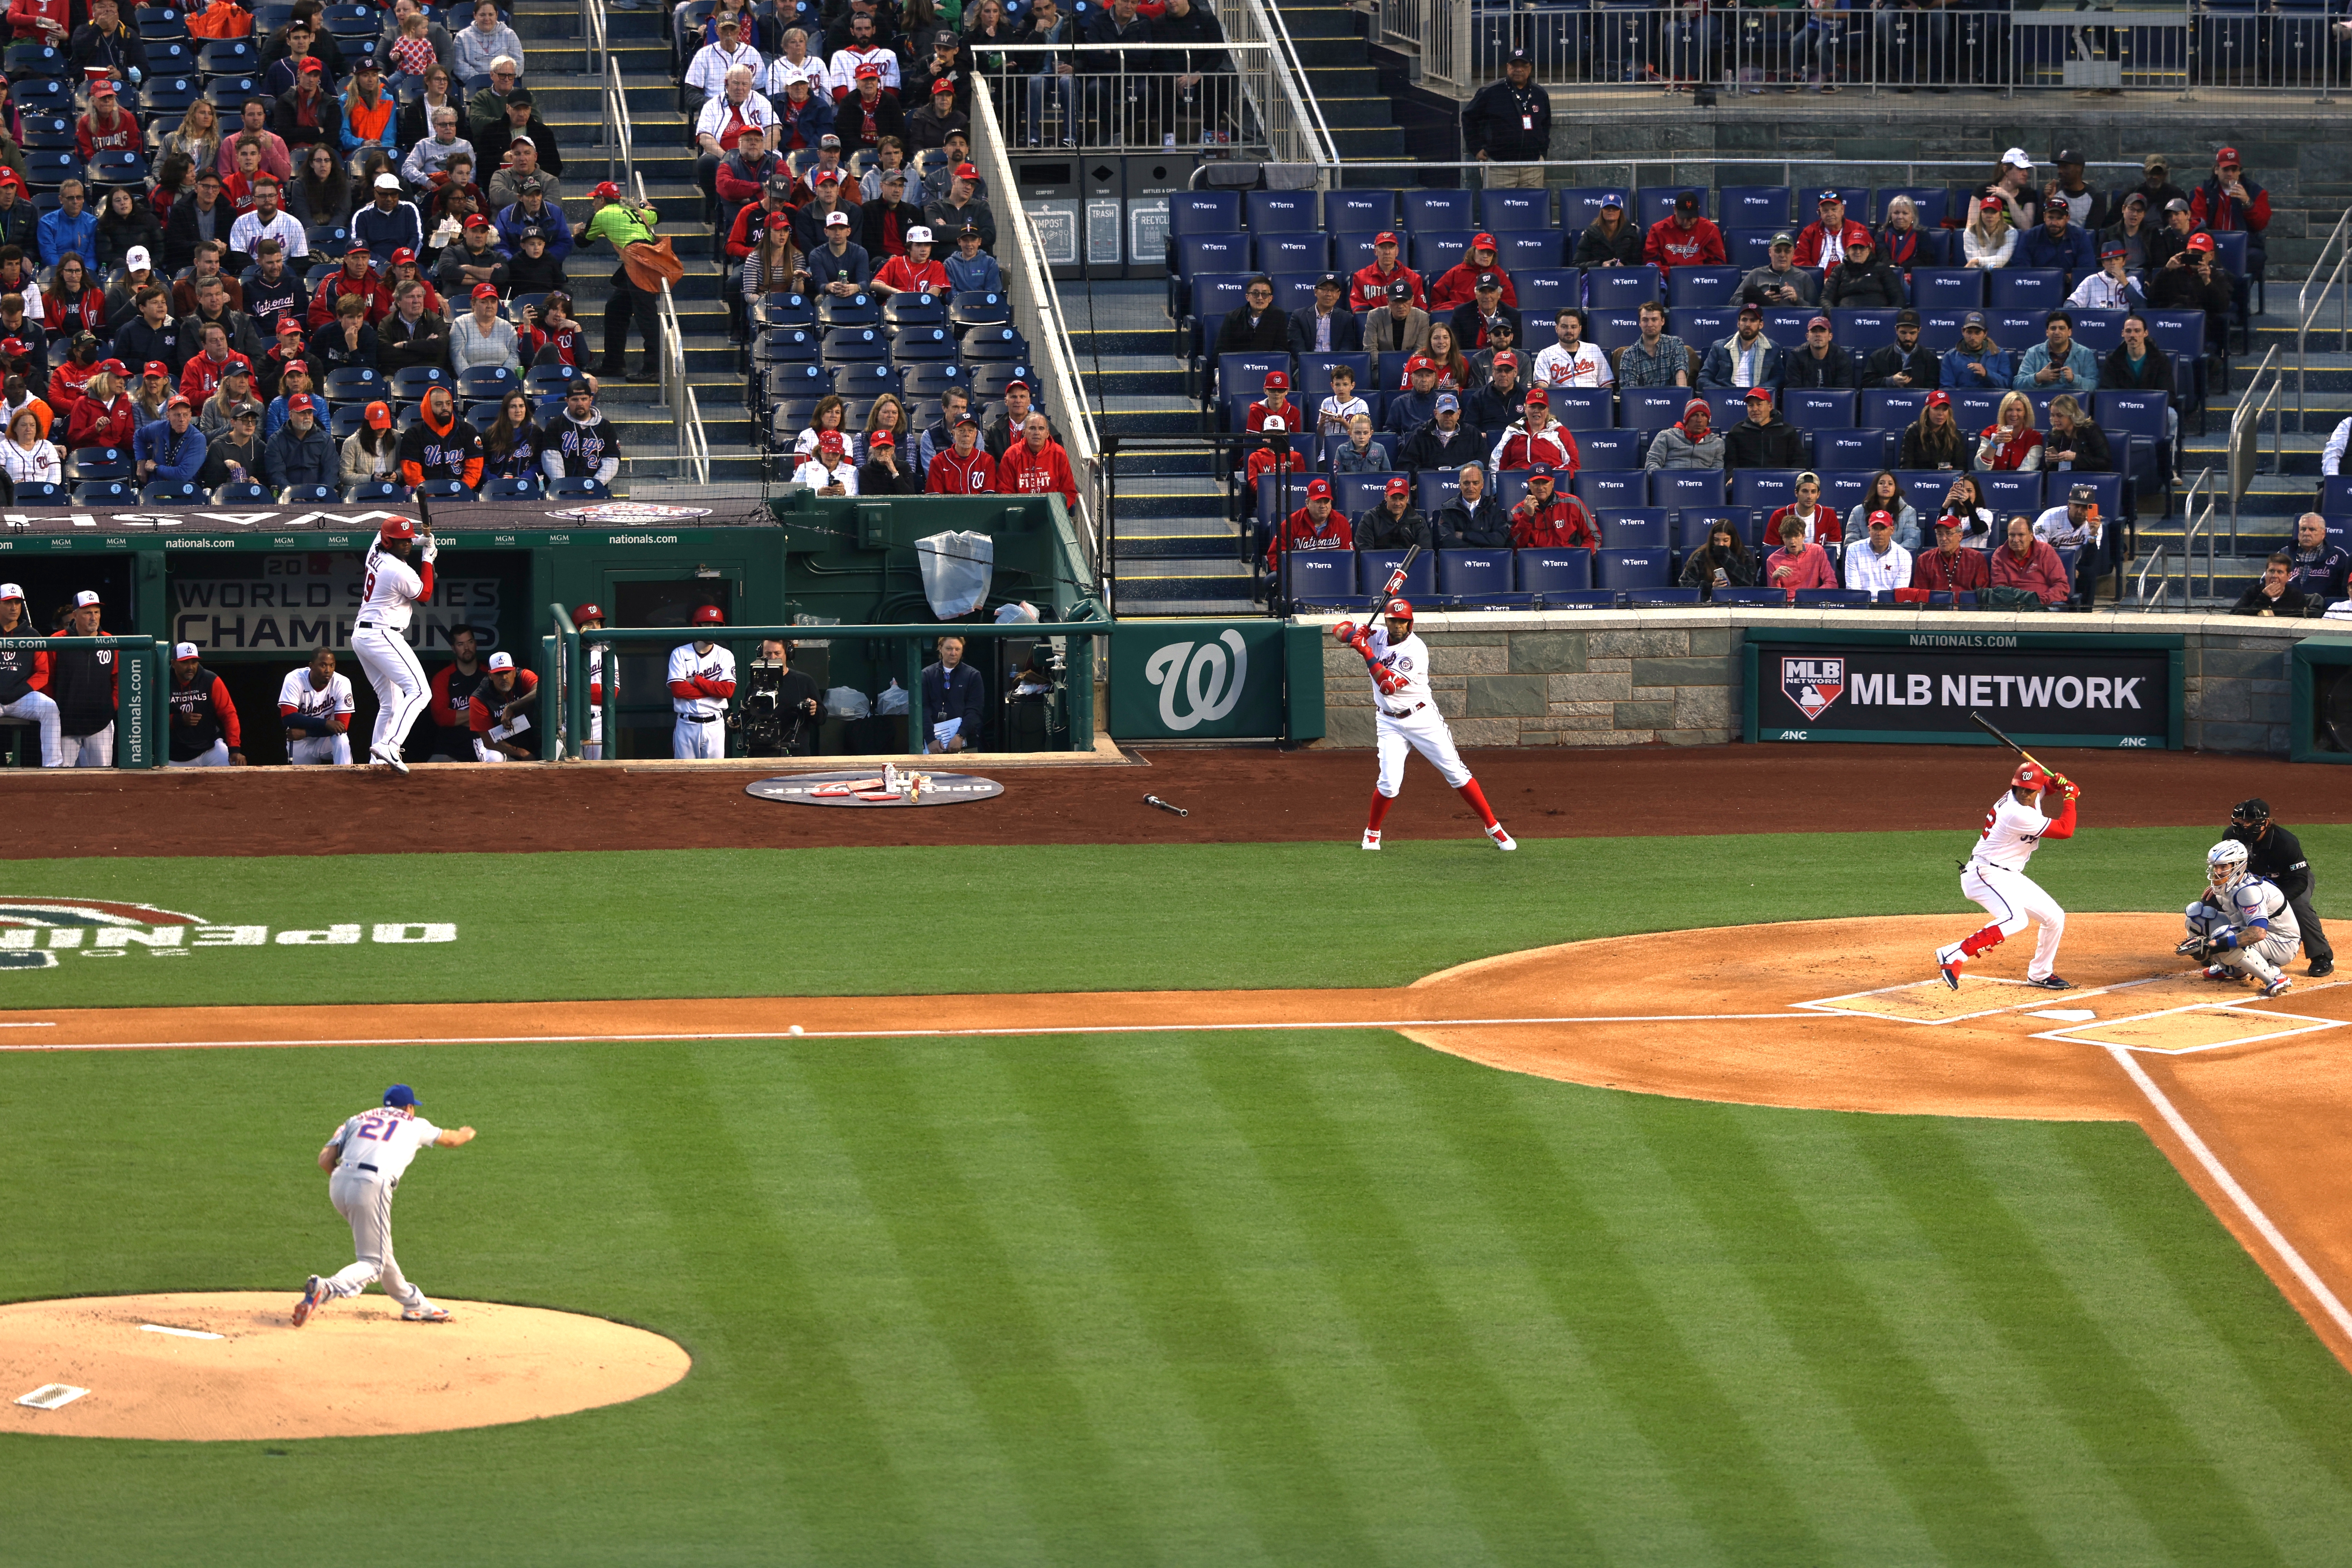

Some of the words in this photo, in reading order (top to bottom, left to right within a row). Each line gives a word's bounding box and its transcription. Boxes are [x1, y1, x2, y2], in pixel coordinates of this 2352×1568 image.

[1092, 210, 1114, 218] TRASH
[166, 538, 234, 548] nationals.com
[609, 534, 677, 544] nationals.com
[1294, 534, 1341, 551] Nationals
[368, 552, 383, 573] BELL
[179, 583, 331, 608] WORLD
[1909, 635, 2017, 648] NATIONALS.COM
[1786, 661, 1840, 678] MLB
[1145, 629, 1247, 730] W
[1851, 673, 1932, 706] MLB
[1942, 675, 2141, 709] NETWORK
[131, 659, 142, 763] nationals.com
[1780, 731, 1807, 740] ANC
[2119, 737, 2147, 746] ANC
[357, 1116, 399, 1142] 21
